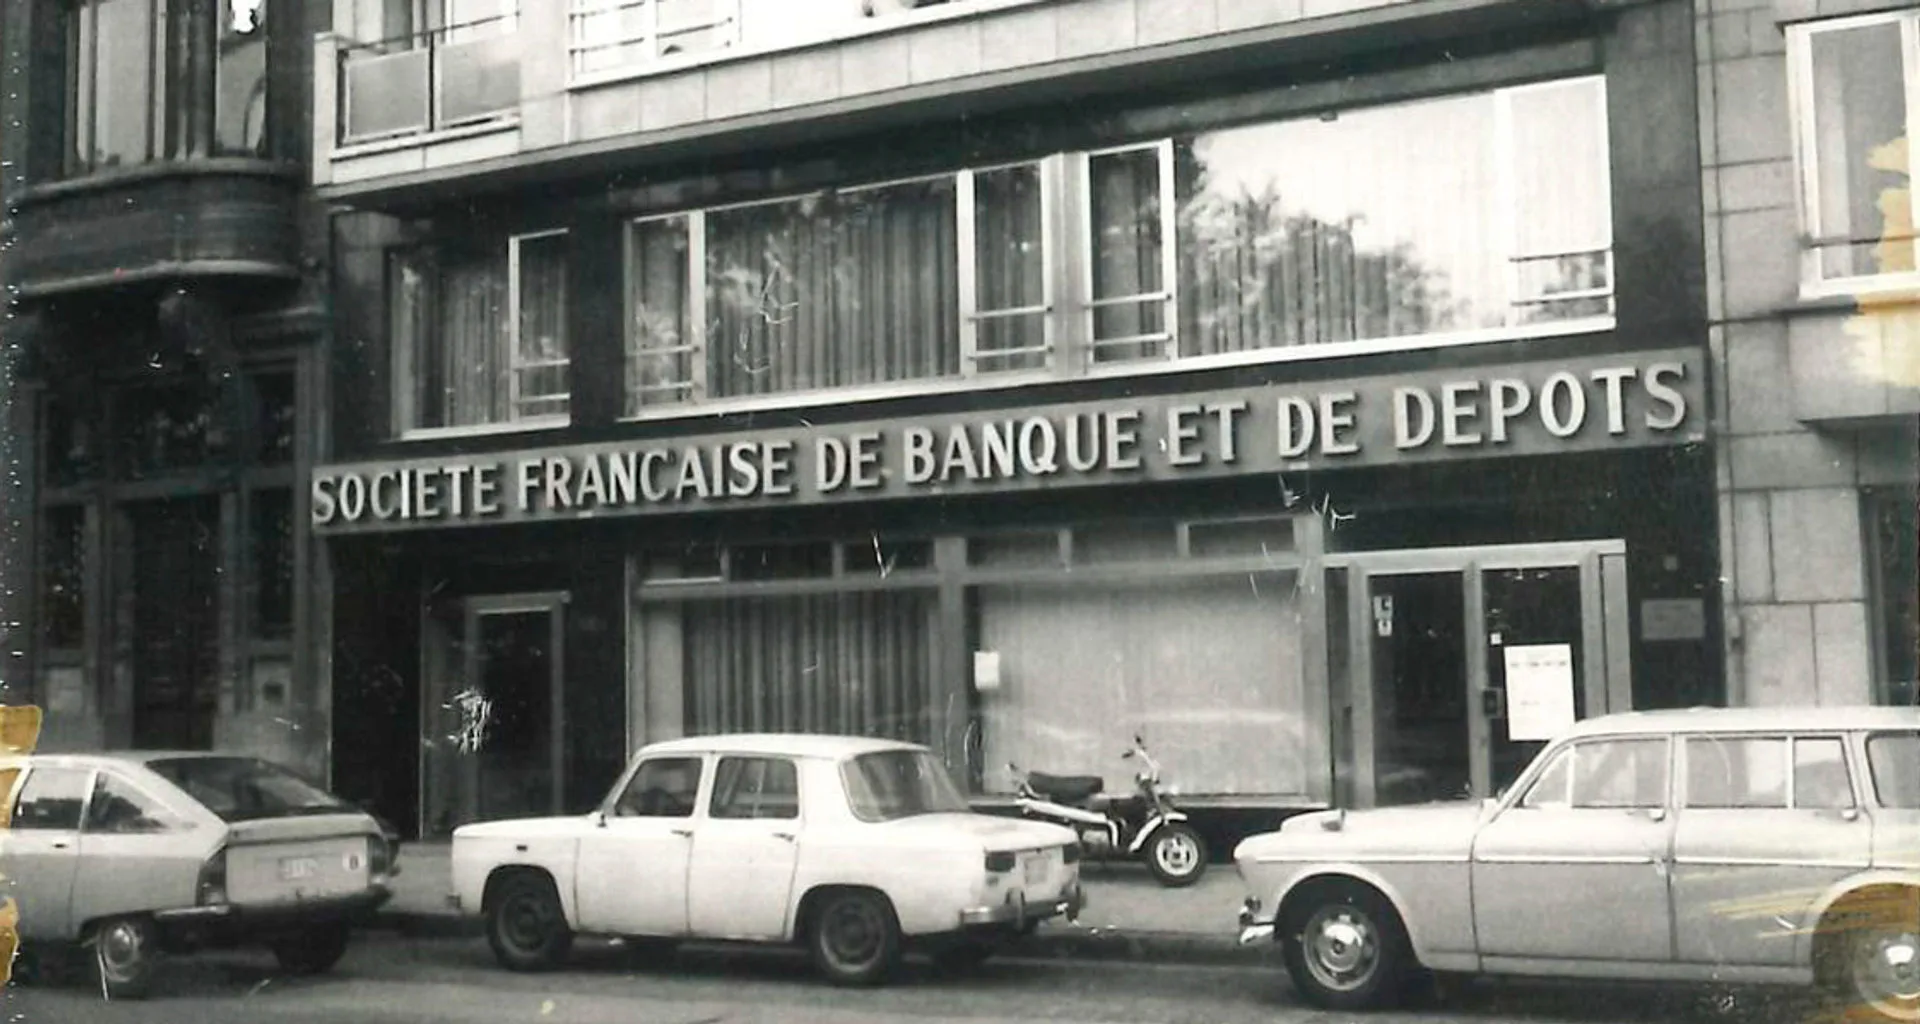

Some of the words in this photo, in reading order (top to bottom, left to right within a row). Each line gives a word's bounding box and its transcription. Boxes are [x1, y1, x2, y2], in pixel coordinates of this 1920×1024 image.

[311, 462, 498, 524] SOCIETE
[517, 440, 793, 511] FRANCAISE
[815, 430, 881, 492] DE
[903, 409, 1141, 484] BANQUE
[1167, 399, 1248, 466] ET
[1276, 390, 1360, 460] DE
[1393, 362, 1687, 450] DEPOTS
